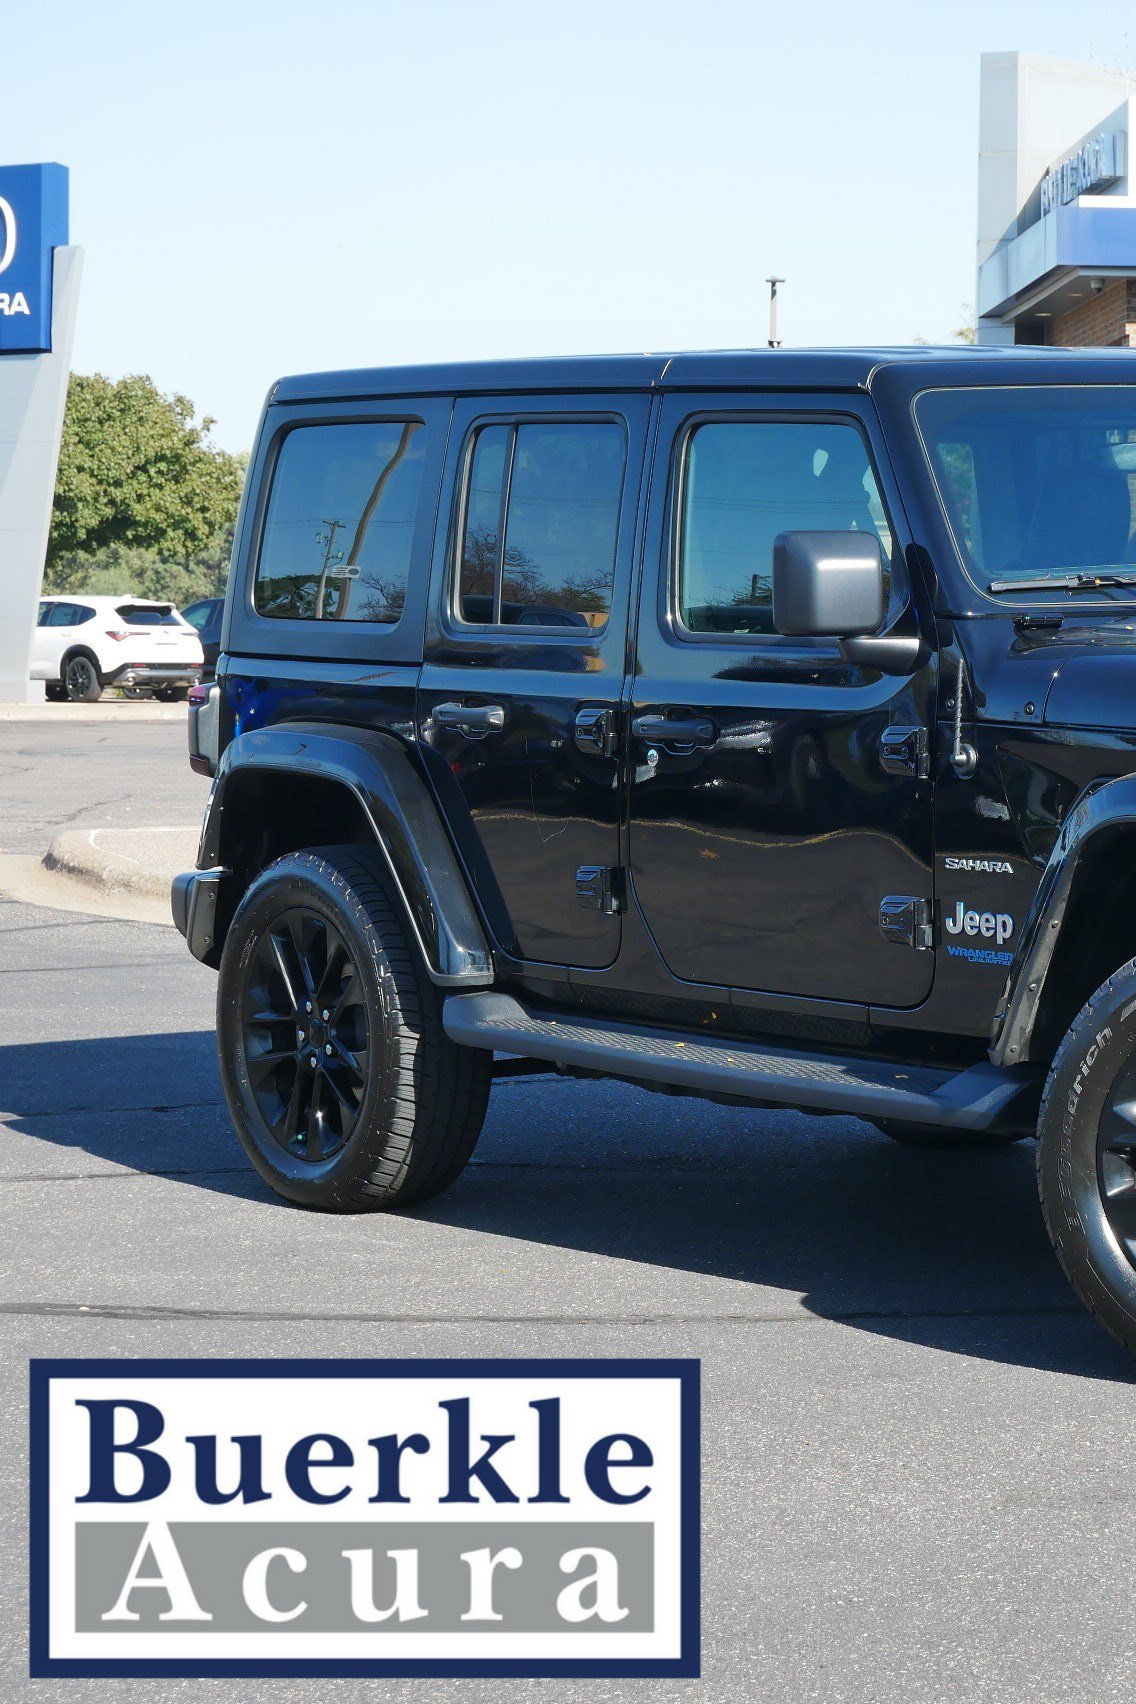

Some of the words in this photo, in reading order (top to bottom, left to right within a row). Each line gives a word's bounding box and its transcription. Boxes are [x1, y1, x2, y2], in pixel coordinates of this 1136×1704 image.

[944, 857, 1014, 874] SAHARA
[945, 901, 1014, 945] Jeep
[946, 945, 1014, 962] WRANGLER
